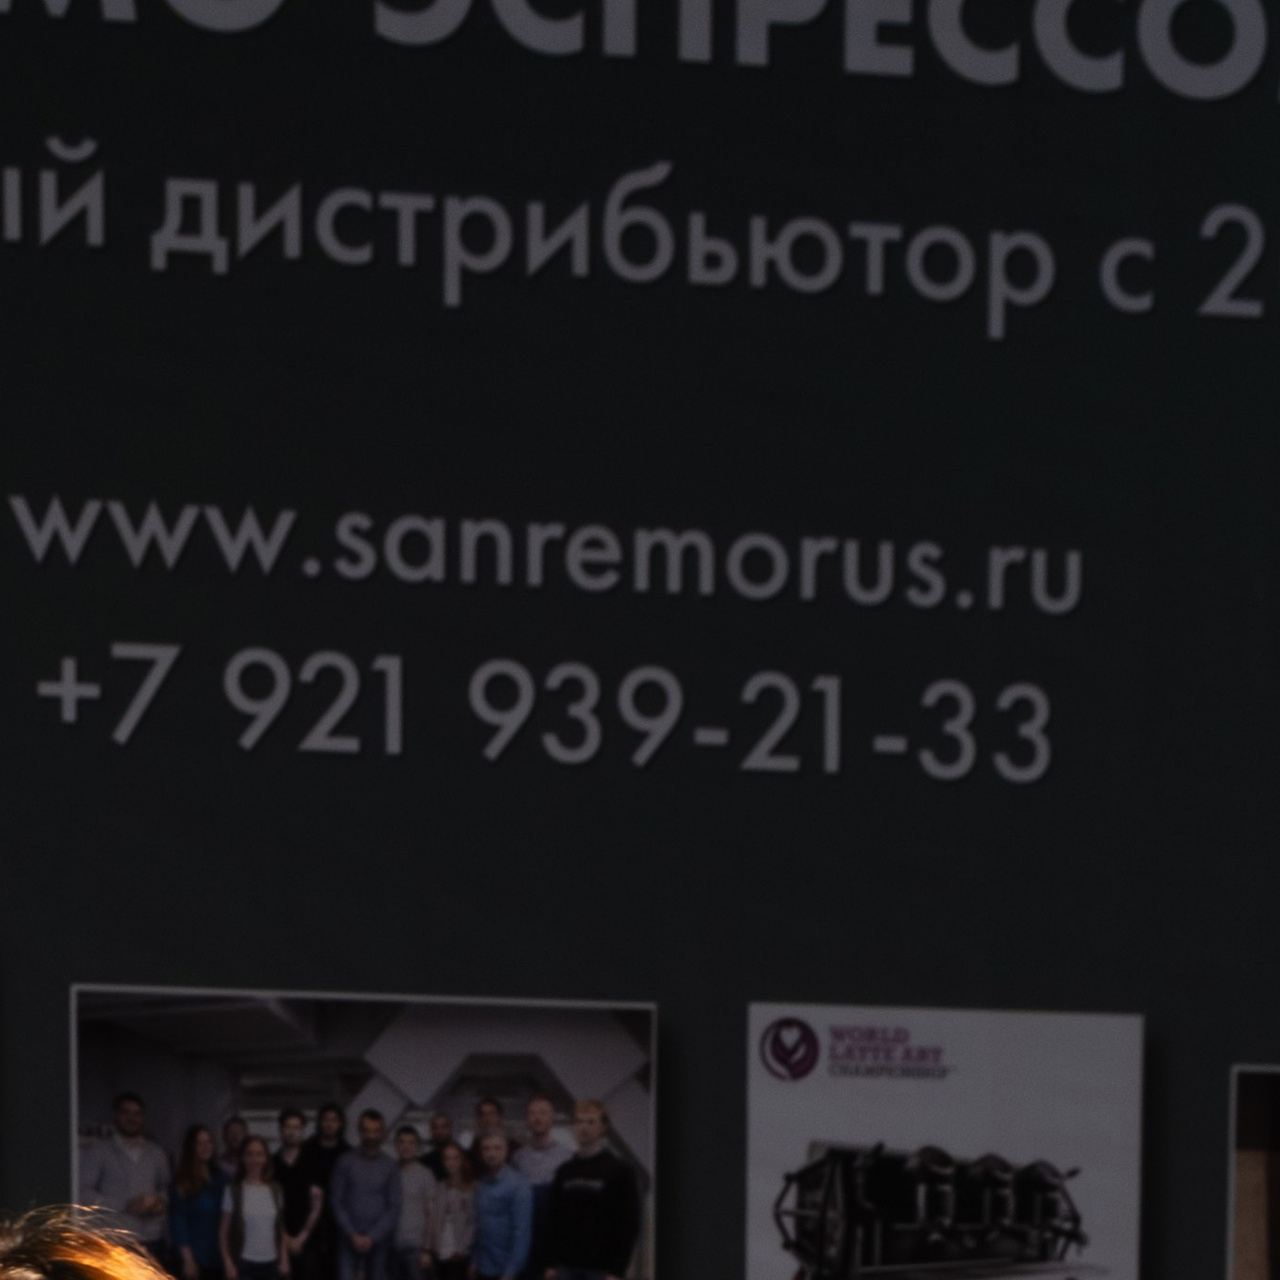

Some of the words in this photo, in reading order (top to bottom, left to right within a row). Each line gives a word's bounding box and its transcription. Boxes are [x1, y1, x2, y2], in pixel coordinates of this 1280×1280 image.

[150, 161, 1056, 340] дистрибьютор
[1100, 237, 1155, 313] с
[8, 495, 1084, 615] www.sanremorus.ru
[36, 643, 181, 746] +7
[222, 647, 402, 756] 921
[466, 659, 1054, 784] 939-21-33
